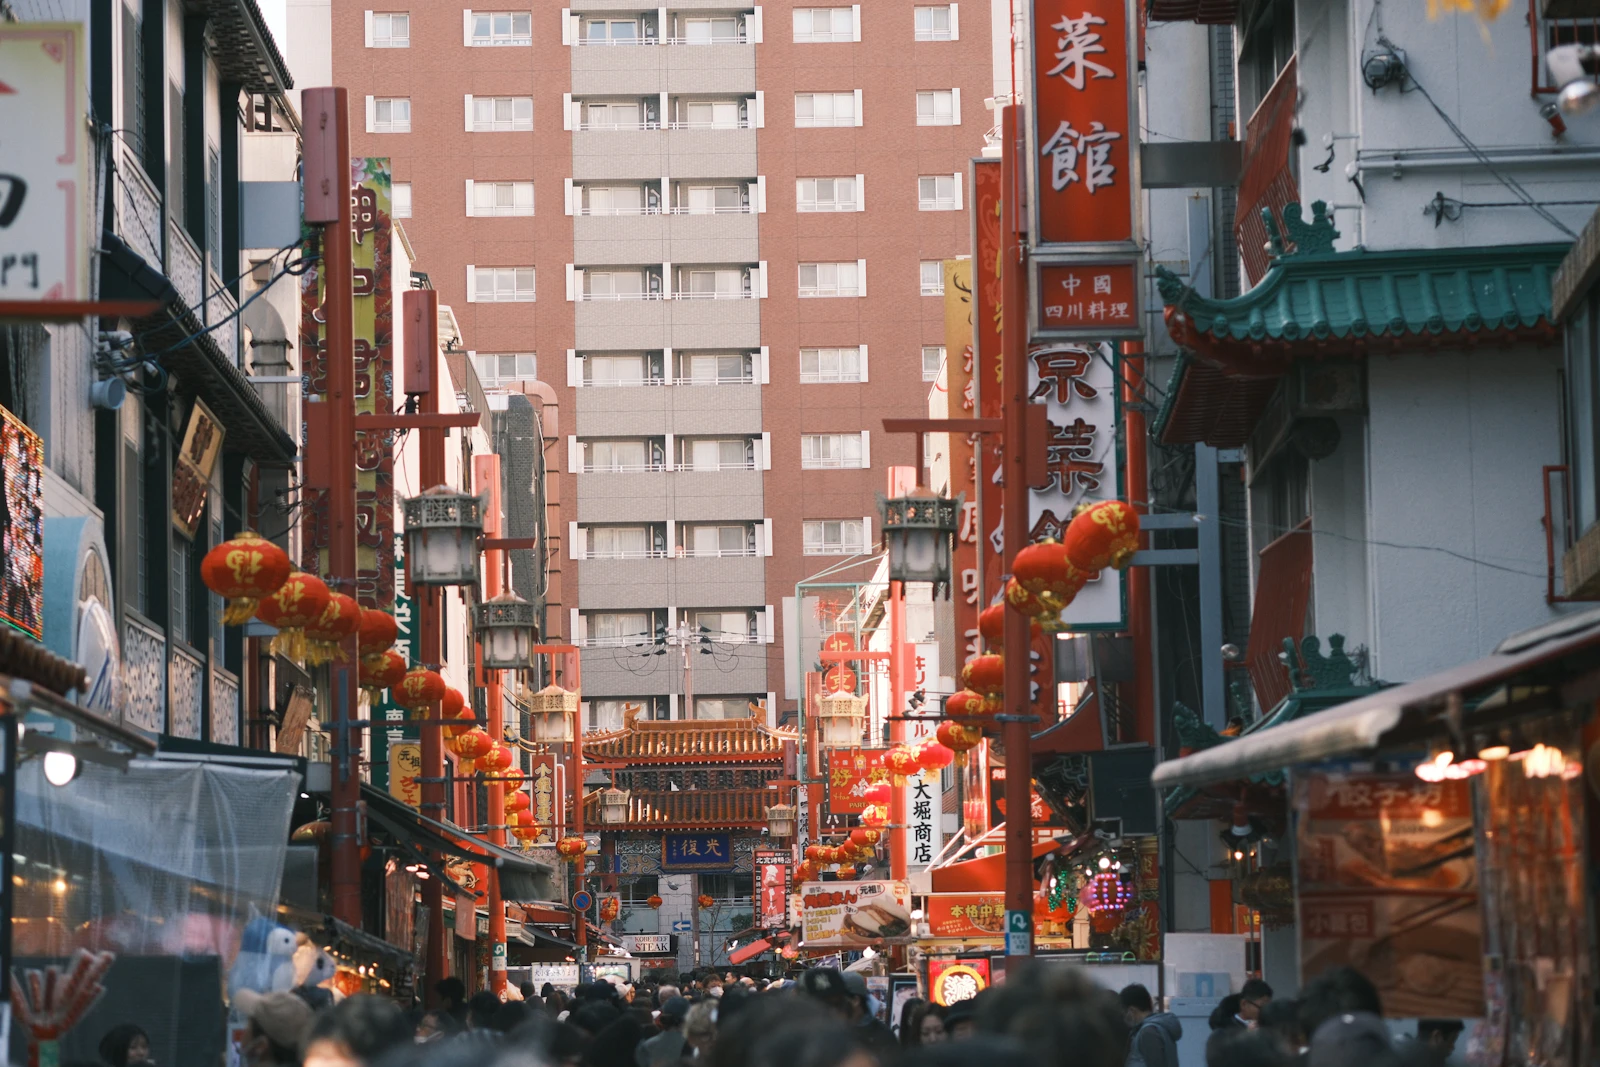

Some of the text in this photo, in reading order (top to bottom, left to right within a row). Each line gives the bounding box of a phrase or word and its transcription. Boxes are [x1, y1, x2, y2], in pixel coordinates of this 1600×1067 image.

[1042, 11, 1120, 194] 菜館
[1062, 273, 1112, 297] 中國
[1045, 301, 1130, 320] 四川料理
[400, 750, 421, 768] 元祖
[912, 779, 932, 864] 大堀商店
[950, 904, 1006, 919] 本格中華
[635, 943, 668, 952] STEAK
